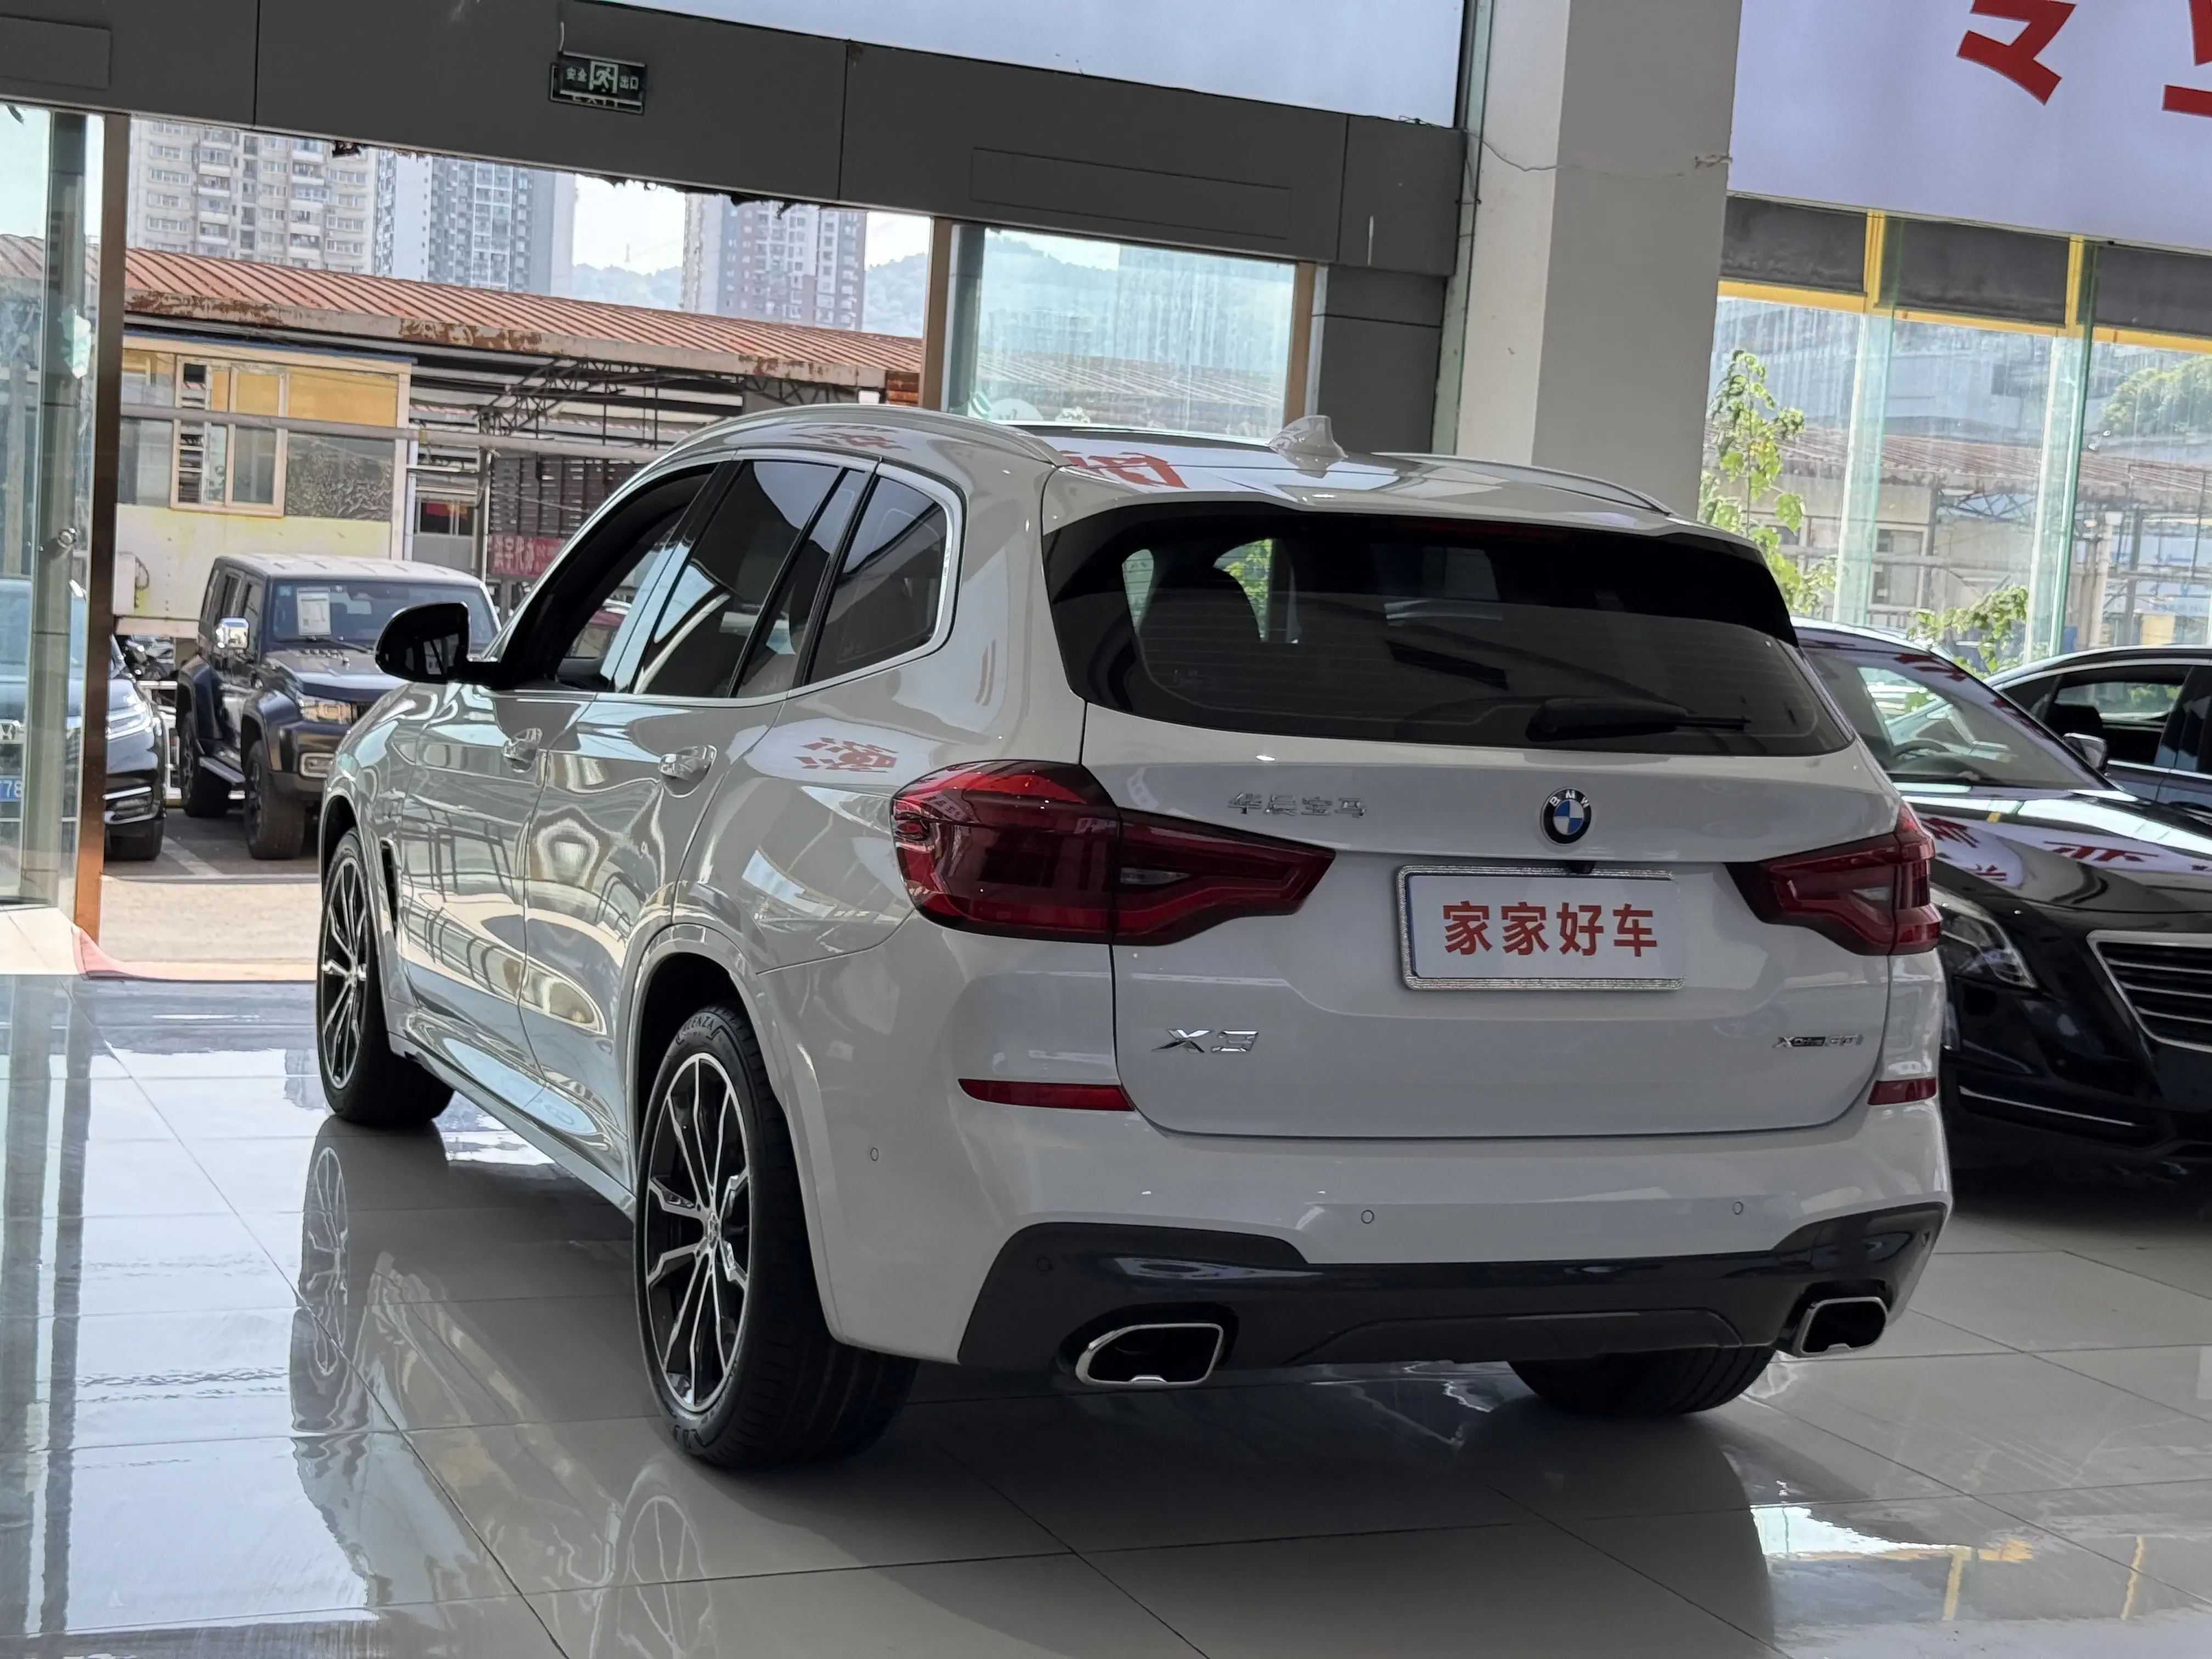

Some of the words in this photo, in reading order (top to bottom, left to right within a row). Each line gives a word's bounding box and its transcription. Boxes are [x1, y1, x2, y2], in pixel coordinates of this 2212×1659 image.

[619, 75, 639, 90] 出口
[1227, 792, 1367, 819] 华晨宝马
[1549, 790, 1590, 808] BMW
[1443, 900, 1657, 957] 家家好车
[1152, 1028, 1259, 1053] X3
